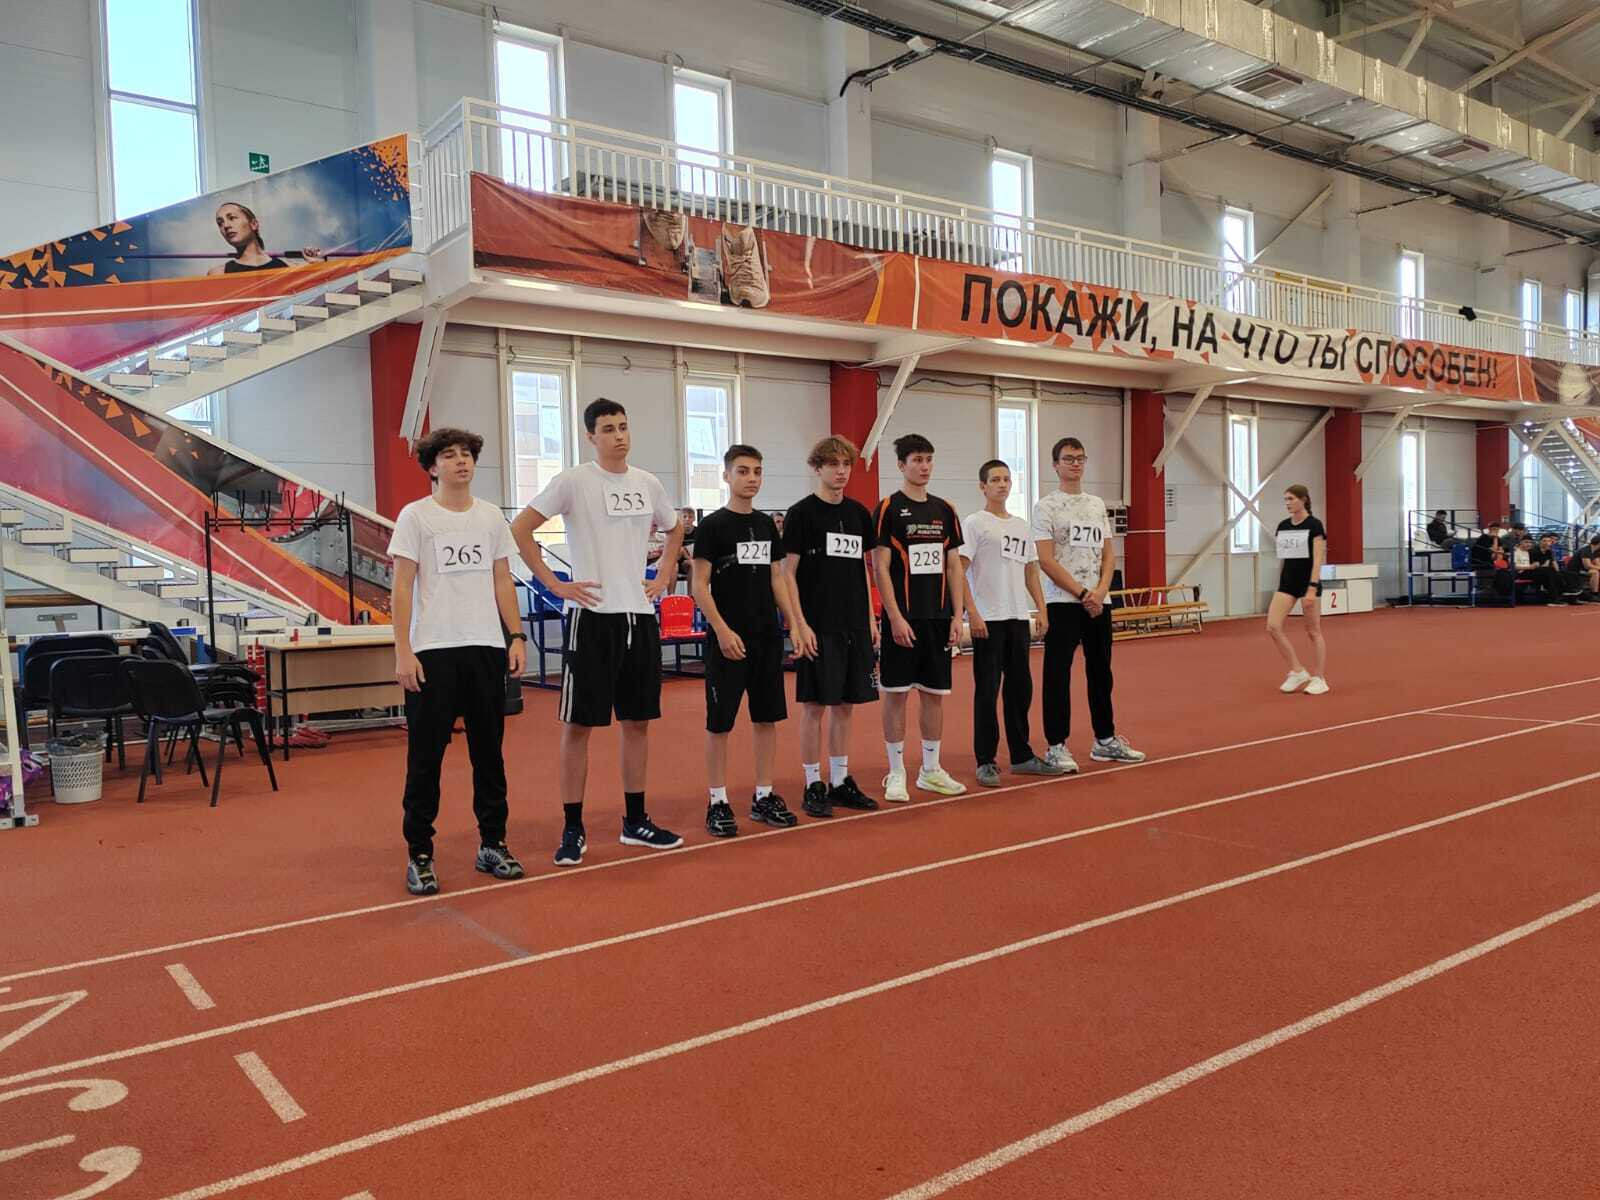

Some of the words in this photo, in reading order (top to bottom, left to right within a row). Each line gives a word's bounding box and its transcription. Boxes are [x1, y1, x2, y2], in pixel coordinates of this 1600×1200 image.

[961, 273, 1157, 352] ПОКАЖИ,
[1171, 305, 1219, 354] НА
[1232, 317, 1300, 366] ЧТО
[1306, 333, 1350, 371] ТЫ
[1355, 336, 1499, 390] СПОСОБЕН!
[611, 492, 644, 511] 253
[1072, 525, 1102, 543] 270
[741, 543, 769, 560] 224
[834, 537, 859, 555] 229
[1003, 535, 1026, 557] 271
[442, 544, 482, 567] 265
[913, 550, 940, 567] 228
[1331, 592, 1337, 608] 2
